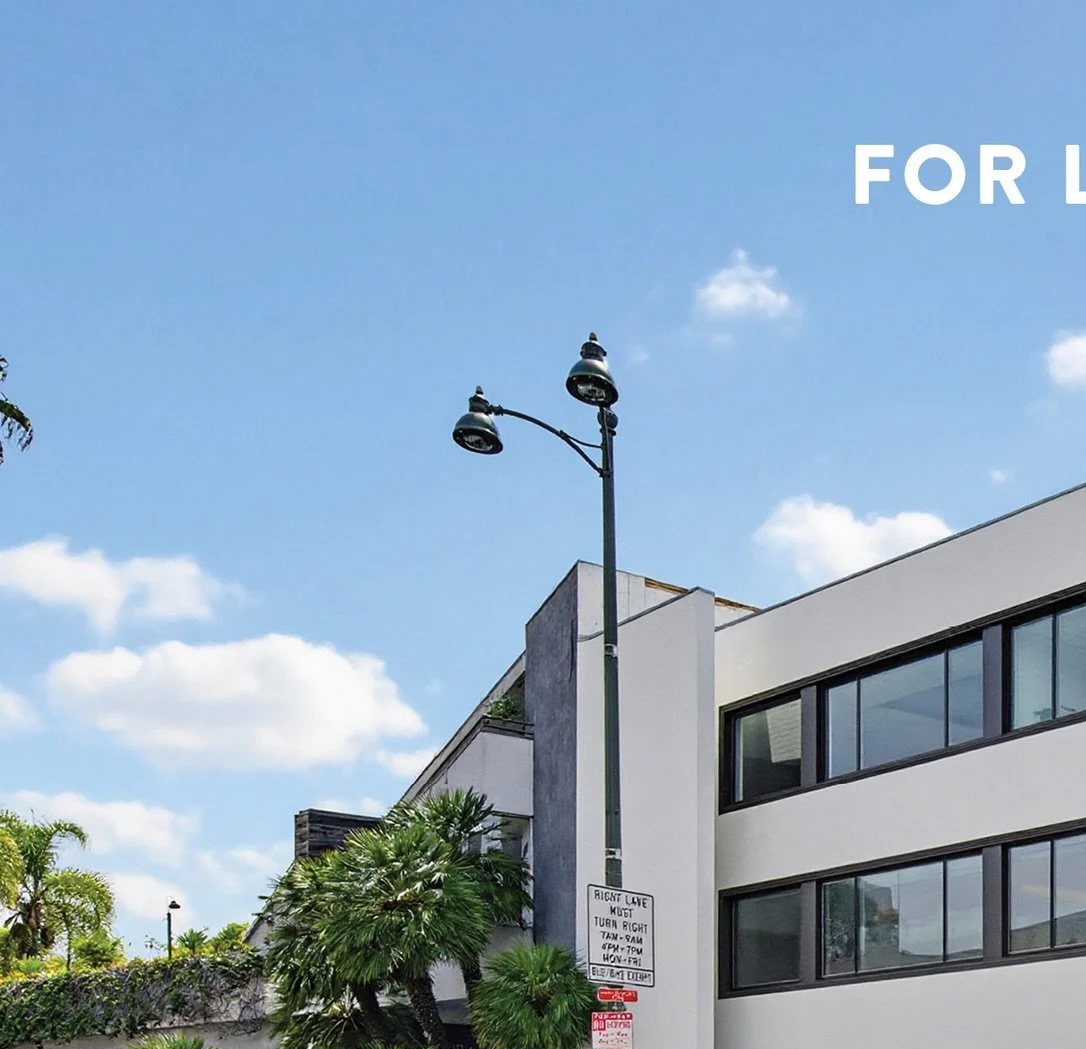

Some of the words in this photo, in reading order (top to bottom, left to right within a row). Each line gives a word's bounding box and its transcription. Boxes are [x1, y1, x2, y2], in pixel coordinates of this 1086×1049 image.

[594, 889, 622, 902] RIGHT
[625, 895, 648, 909] LANE
[609, 905, 634, 919] MUST
[594, 916, 618, 930] TURN
[622, 920, 648, 934] RIGHT
